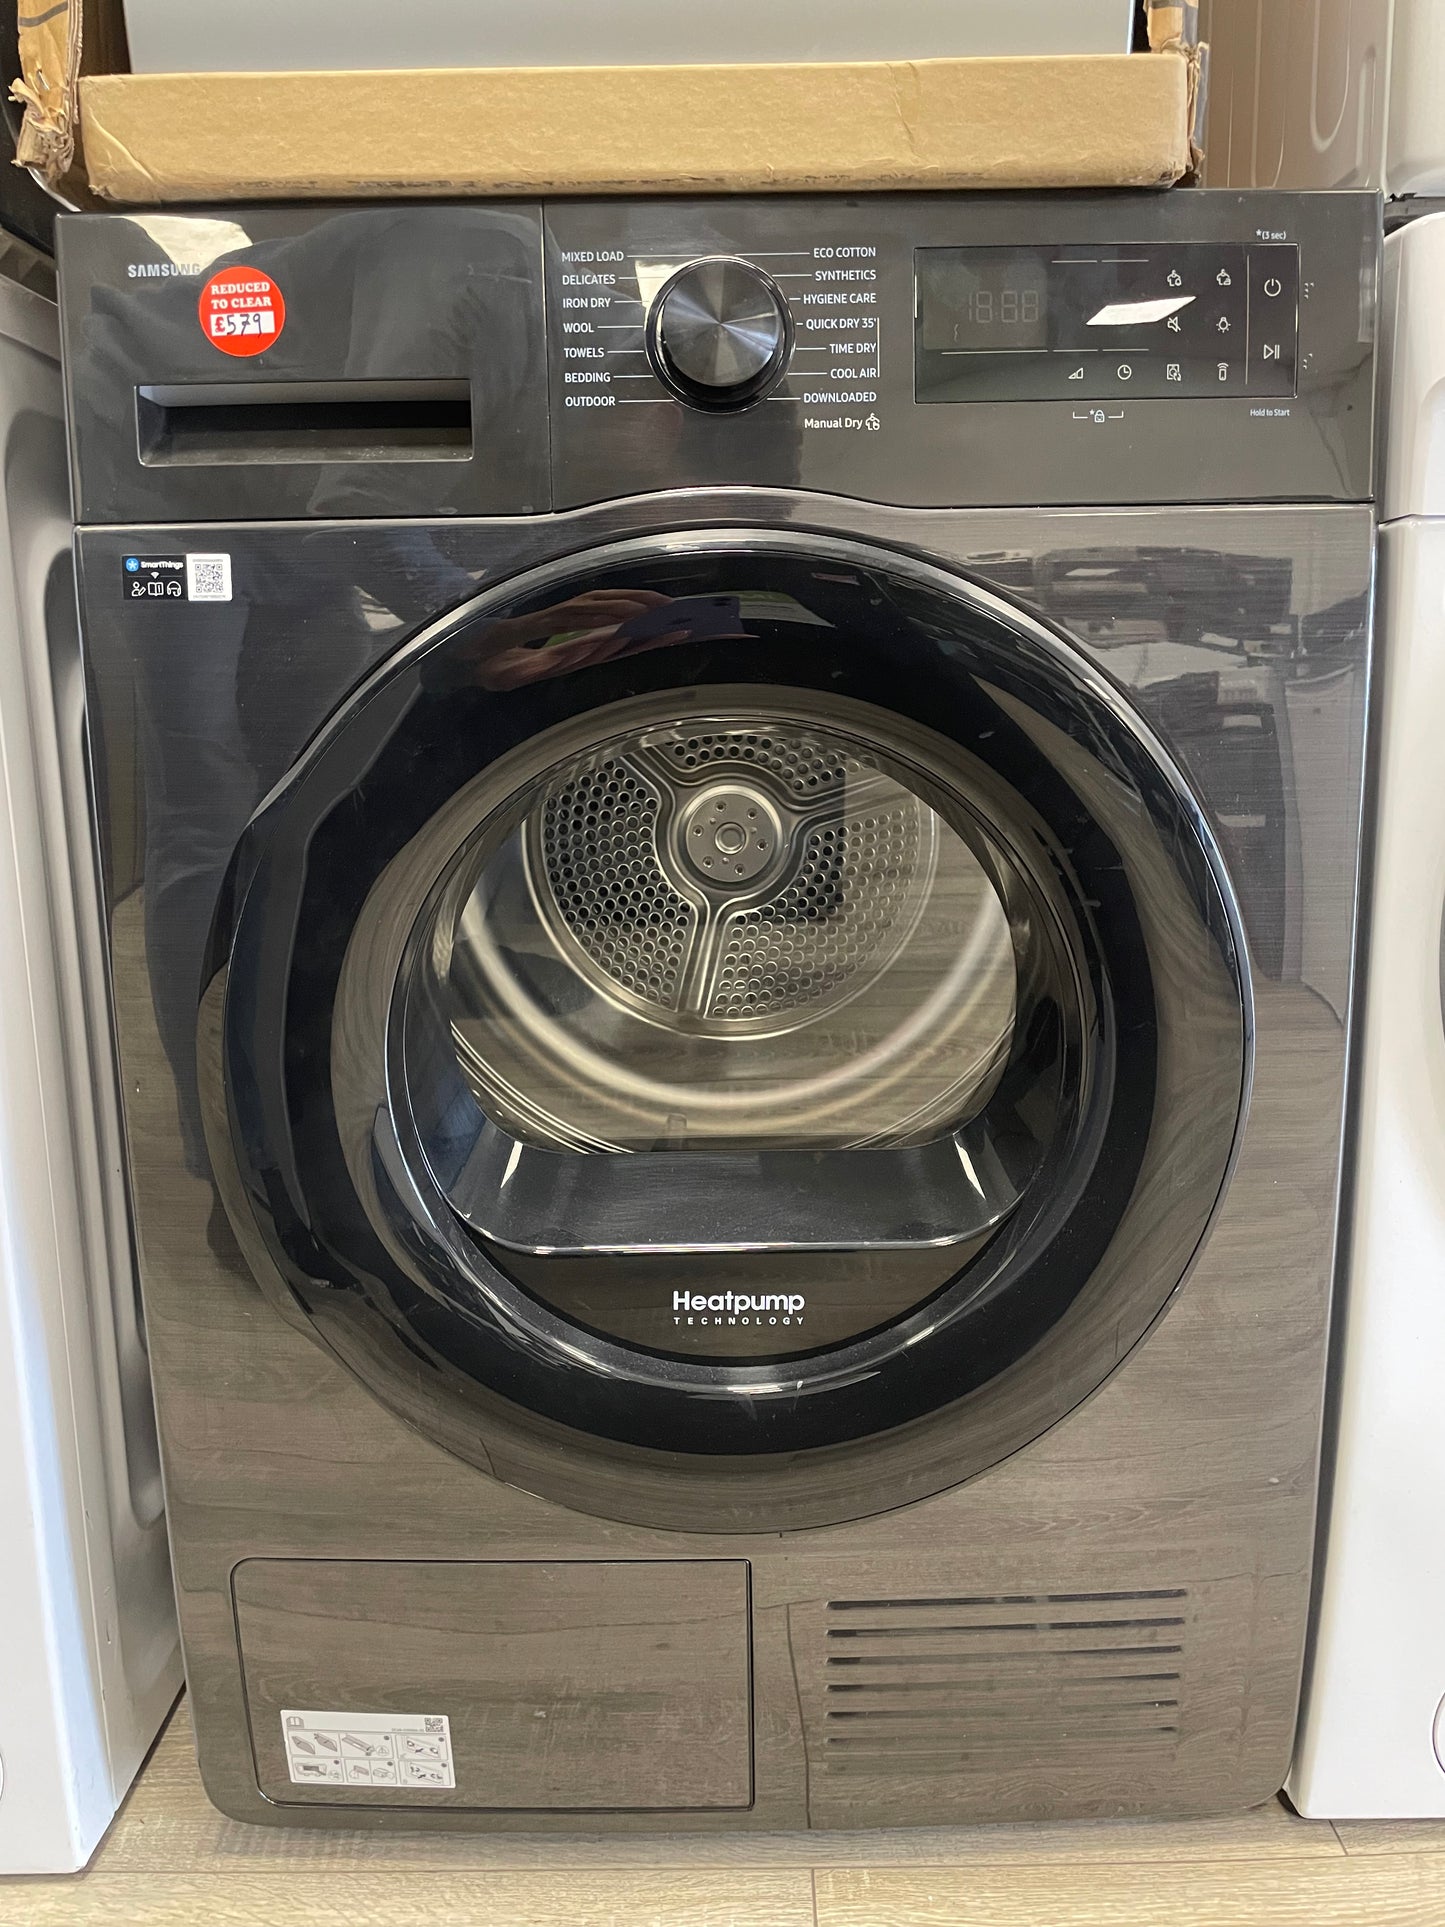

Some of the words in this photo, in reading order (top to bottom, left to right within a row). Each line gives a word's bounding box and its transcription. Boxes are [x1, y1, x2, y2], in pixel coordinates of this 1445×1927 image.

[561, 251, 594, 262] MIXED
[596, 251, 624, 262] LOAD
[813, 247, 834, 258] ECO
[835, 246, 876, 258] COTTON
[127, 263, 201, 278] SAMSUNG
[815, 269, 877, 281] SYNTHETICS
[562, 274, 616, 285] DELICATES
[210, 281, 270, 295] REDUCED
[211, 299, 228, 310] TO
[231, 296, 272, 309] CLEAR
[562, 298, 588, 309] IRON
[590, 297, 611, 308] DRY
[803, 293, 848, 304] HYGIENE
[849, 293, 877, 304] CARE
[214, 312, 263, 338] £579
[563, 322, 595, 333] WOOL
[806, 318, 838, 331] QUICK
[839, 318, 860, 329] DRY
[563, 347, 605, 358] TOWELS
[829, 343, 854, 354] TIME
[856, 342, 877, 353] DRY
[564, 372, 611, 383] BEDDING
[830, 368, 858, 379] COOL
[859, 367, 877, 378] AIR
[565, 396, 616, 407] OUTDOOR
[803, 392, 877, 403] DOWNLOADED
[1250, 408, 1266, 417] Hold
[1266, 409, 1273, 417] to
[1273, 408, 1290, 417] Start
[804, 417, 843, 429] Manual
[844, 417, 863, 430] Dry
[140, 560, 184, 571] SmartThings
[673, 1290, 805, 1315] Heatpump
[673, 1317, 804, 1325] TECHNOLOGY
